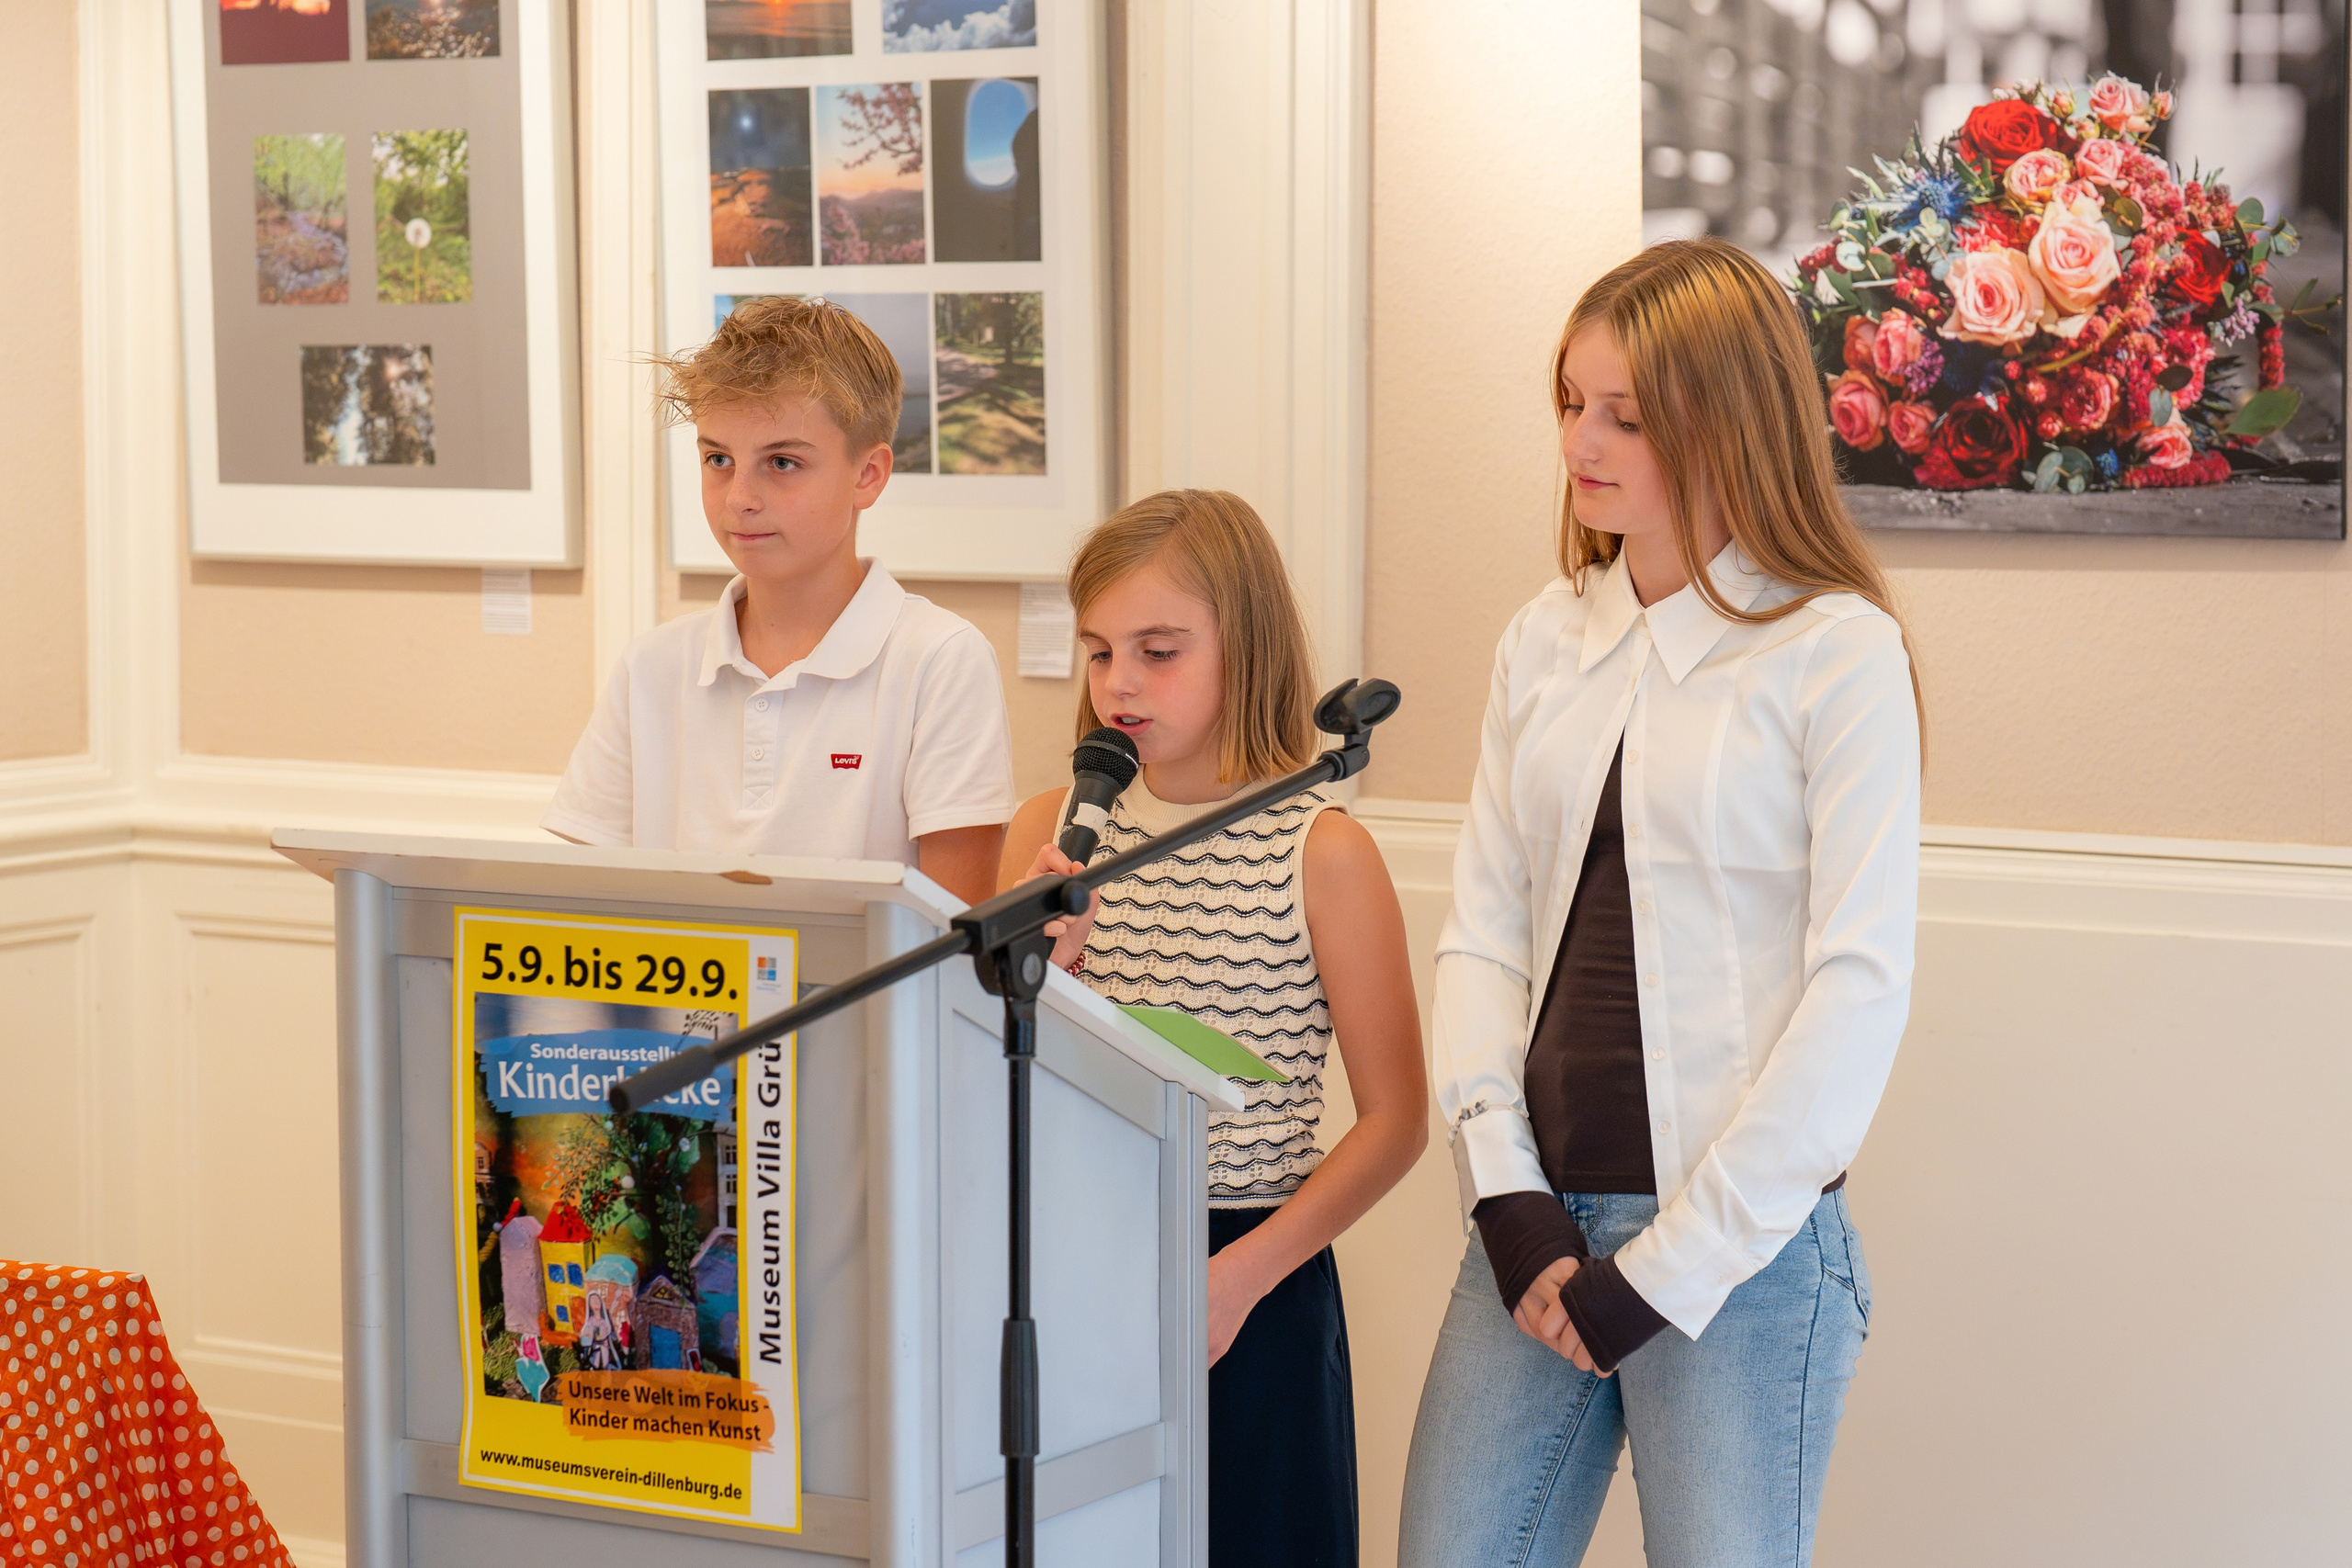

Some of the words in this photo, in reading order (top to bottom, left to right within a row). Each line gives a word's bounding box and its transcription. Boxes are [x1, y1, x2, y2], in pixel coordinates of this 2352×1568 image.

[481, 942, 554, 985] 5.9.
[563, 945, 622, 990] bis
[635, 954, 738, 999] 29.9.
[530, 1043, 684, 1062] Sonderausstell
[758, 1042, 781, 1107] Grü
[499, 1061, 720, 1106] Kinderke
[757, 1120, 781, 1199] Villa
[759, 1210, 781, 1364] Museum
[569, 1382, 630, 1403] Unsere
[634, 1386, 673, 1405] Welt
[678, 1389, 700, 1408] im
[706, 1392, 760, 1413] Fokus
[570, 1408, 628, 1430] Kinder
[633, 1414, 704, 1436] machen
[708, 1420, 761, 1441] Kunst
[481, 1450, 742, 1500] www.museumsverein-dillenburg.de
